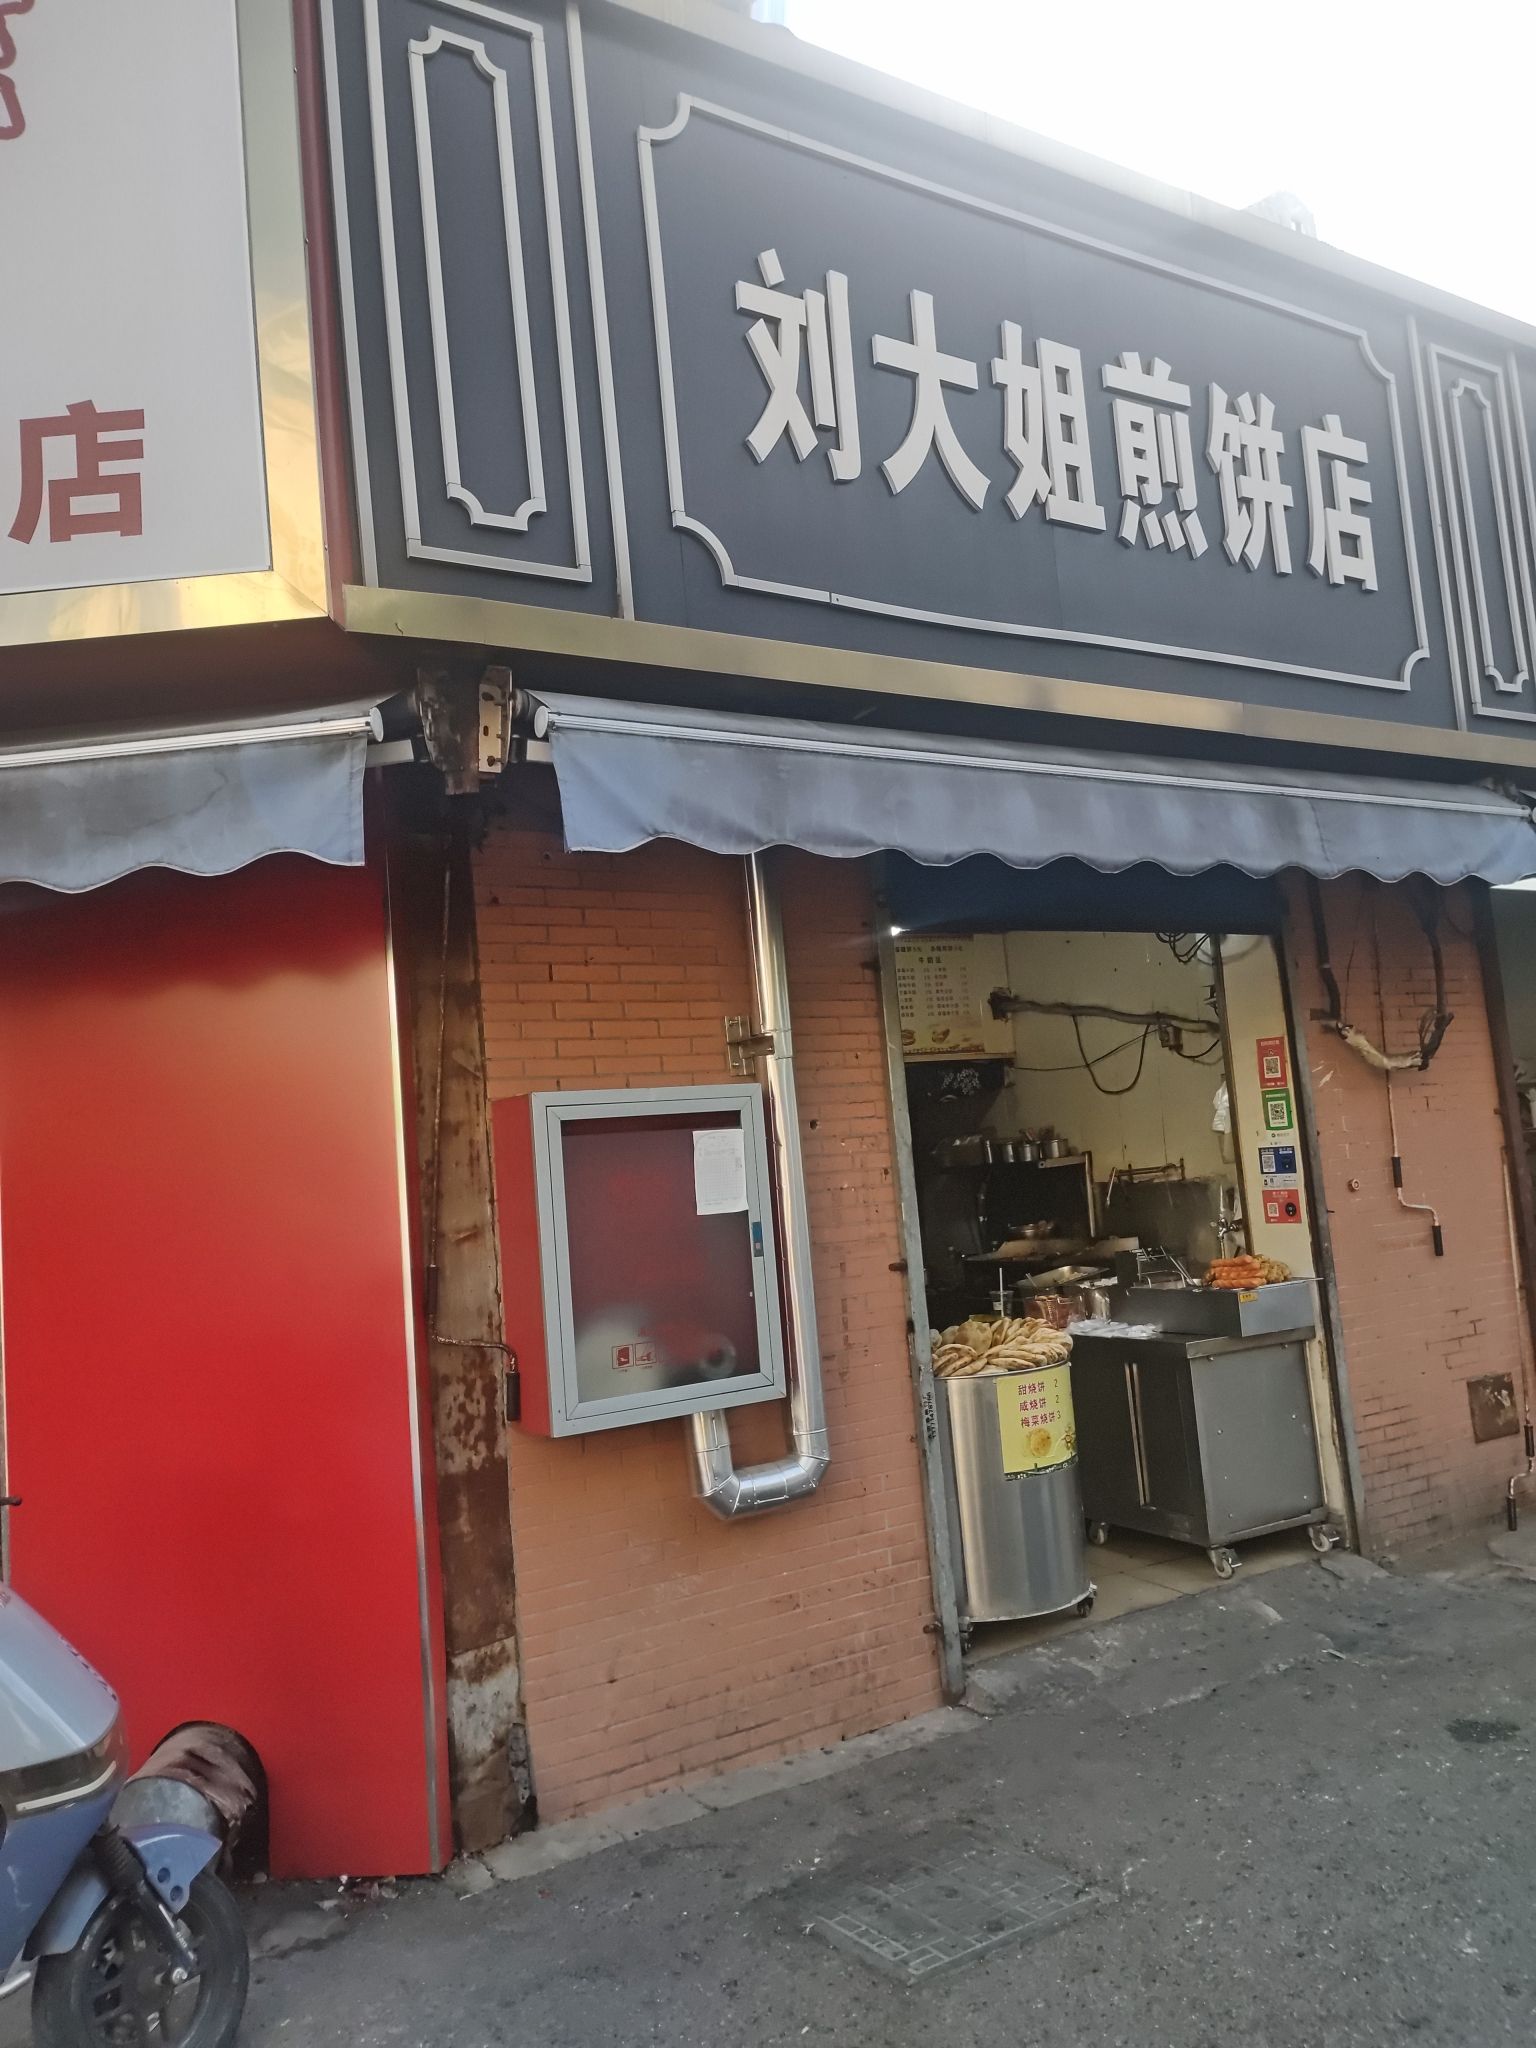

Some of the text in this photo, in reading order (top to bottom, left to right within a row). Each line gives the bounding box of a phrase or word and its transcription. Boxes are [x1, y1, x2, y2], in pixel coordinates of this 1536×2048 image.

[735, 248, 1379, 592] 刘大姐煎饼店
[8, 399, 145, 544] 店
[1018, 1378, 1058, 1396] 甜烧饼 2
[1019, 1394, 1060, 1412] 咸烧饼 2
[1020, 1411, 1055, 1428] 梅菜烧饼
